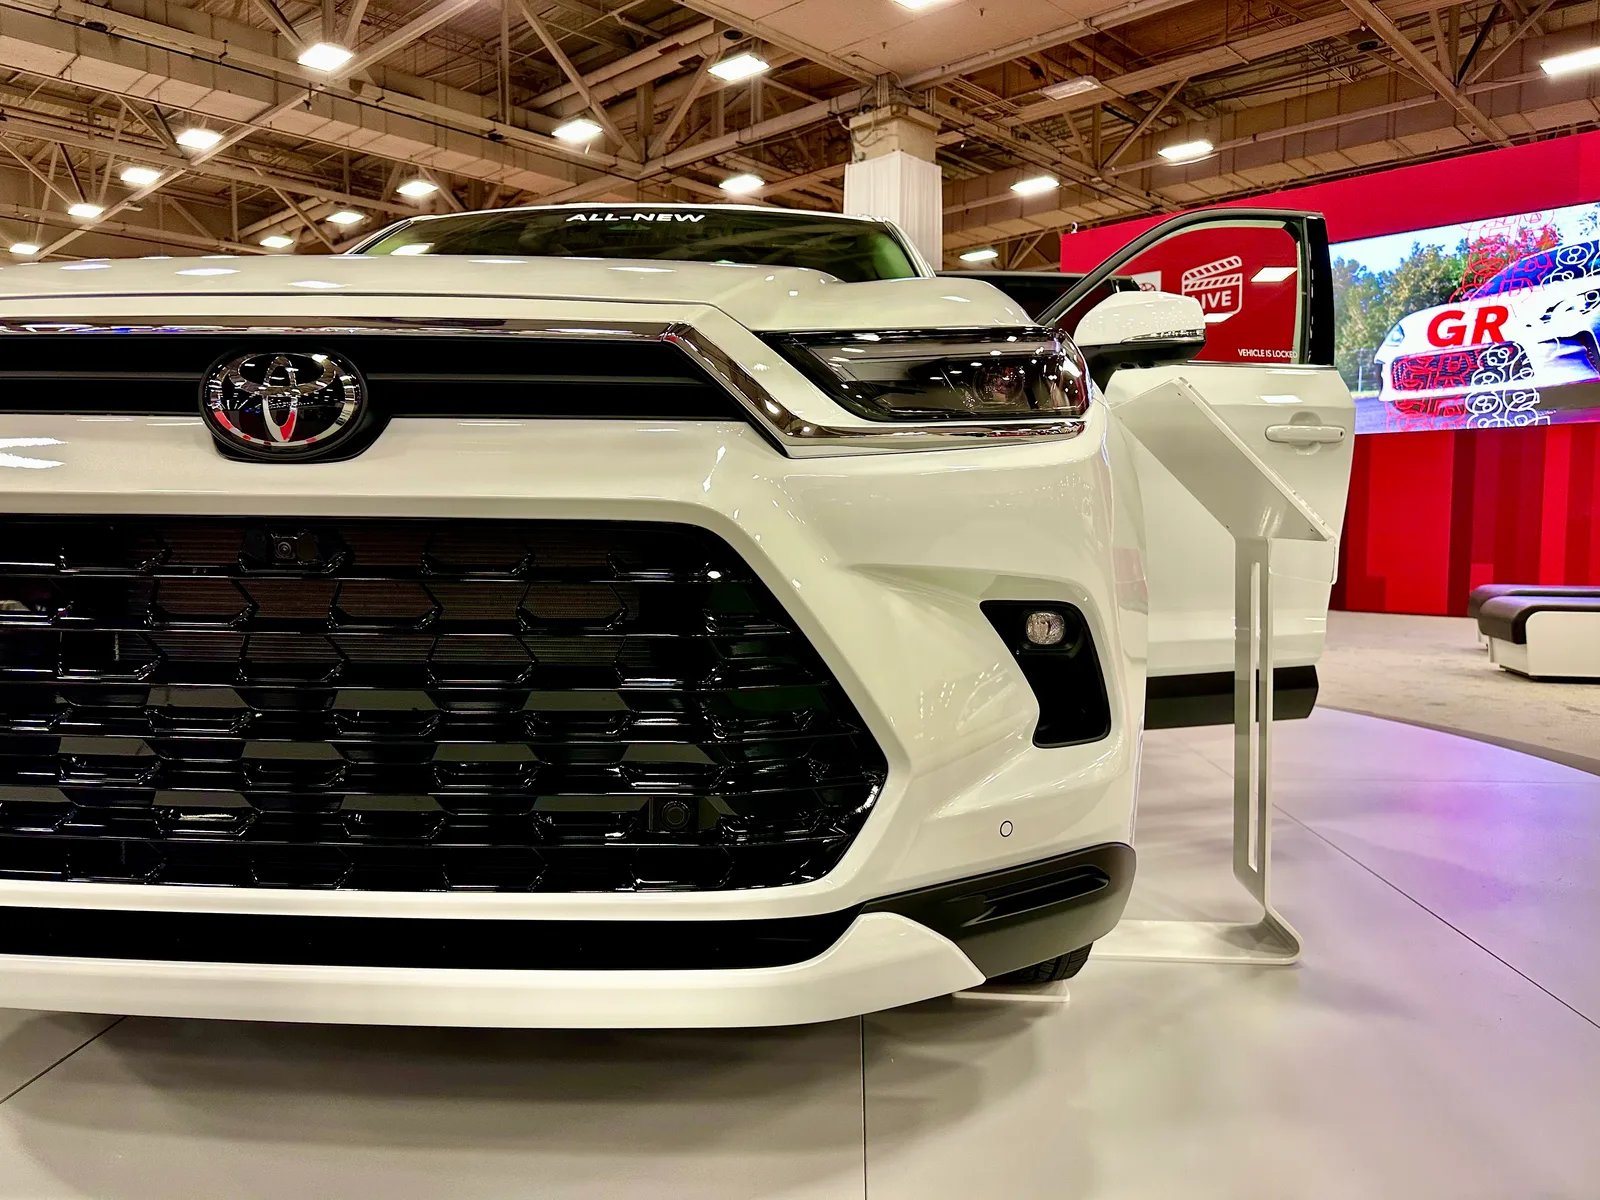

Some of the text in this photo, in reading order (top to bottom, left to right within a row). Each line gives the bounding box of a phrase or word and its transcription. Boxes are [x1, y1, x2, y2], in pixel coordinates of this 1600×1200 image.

[565, 213, 706, 223] ALL-NEW
[1191, 289, 1232, 310] IVE
[1427, 305, 1509, 347] GR
[1237, 348, 1298, 359] VEHICLE IS LOCKED
